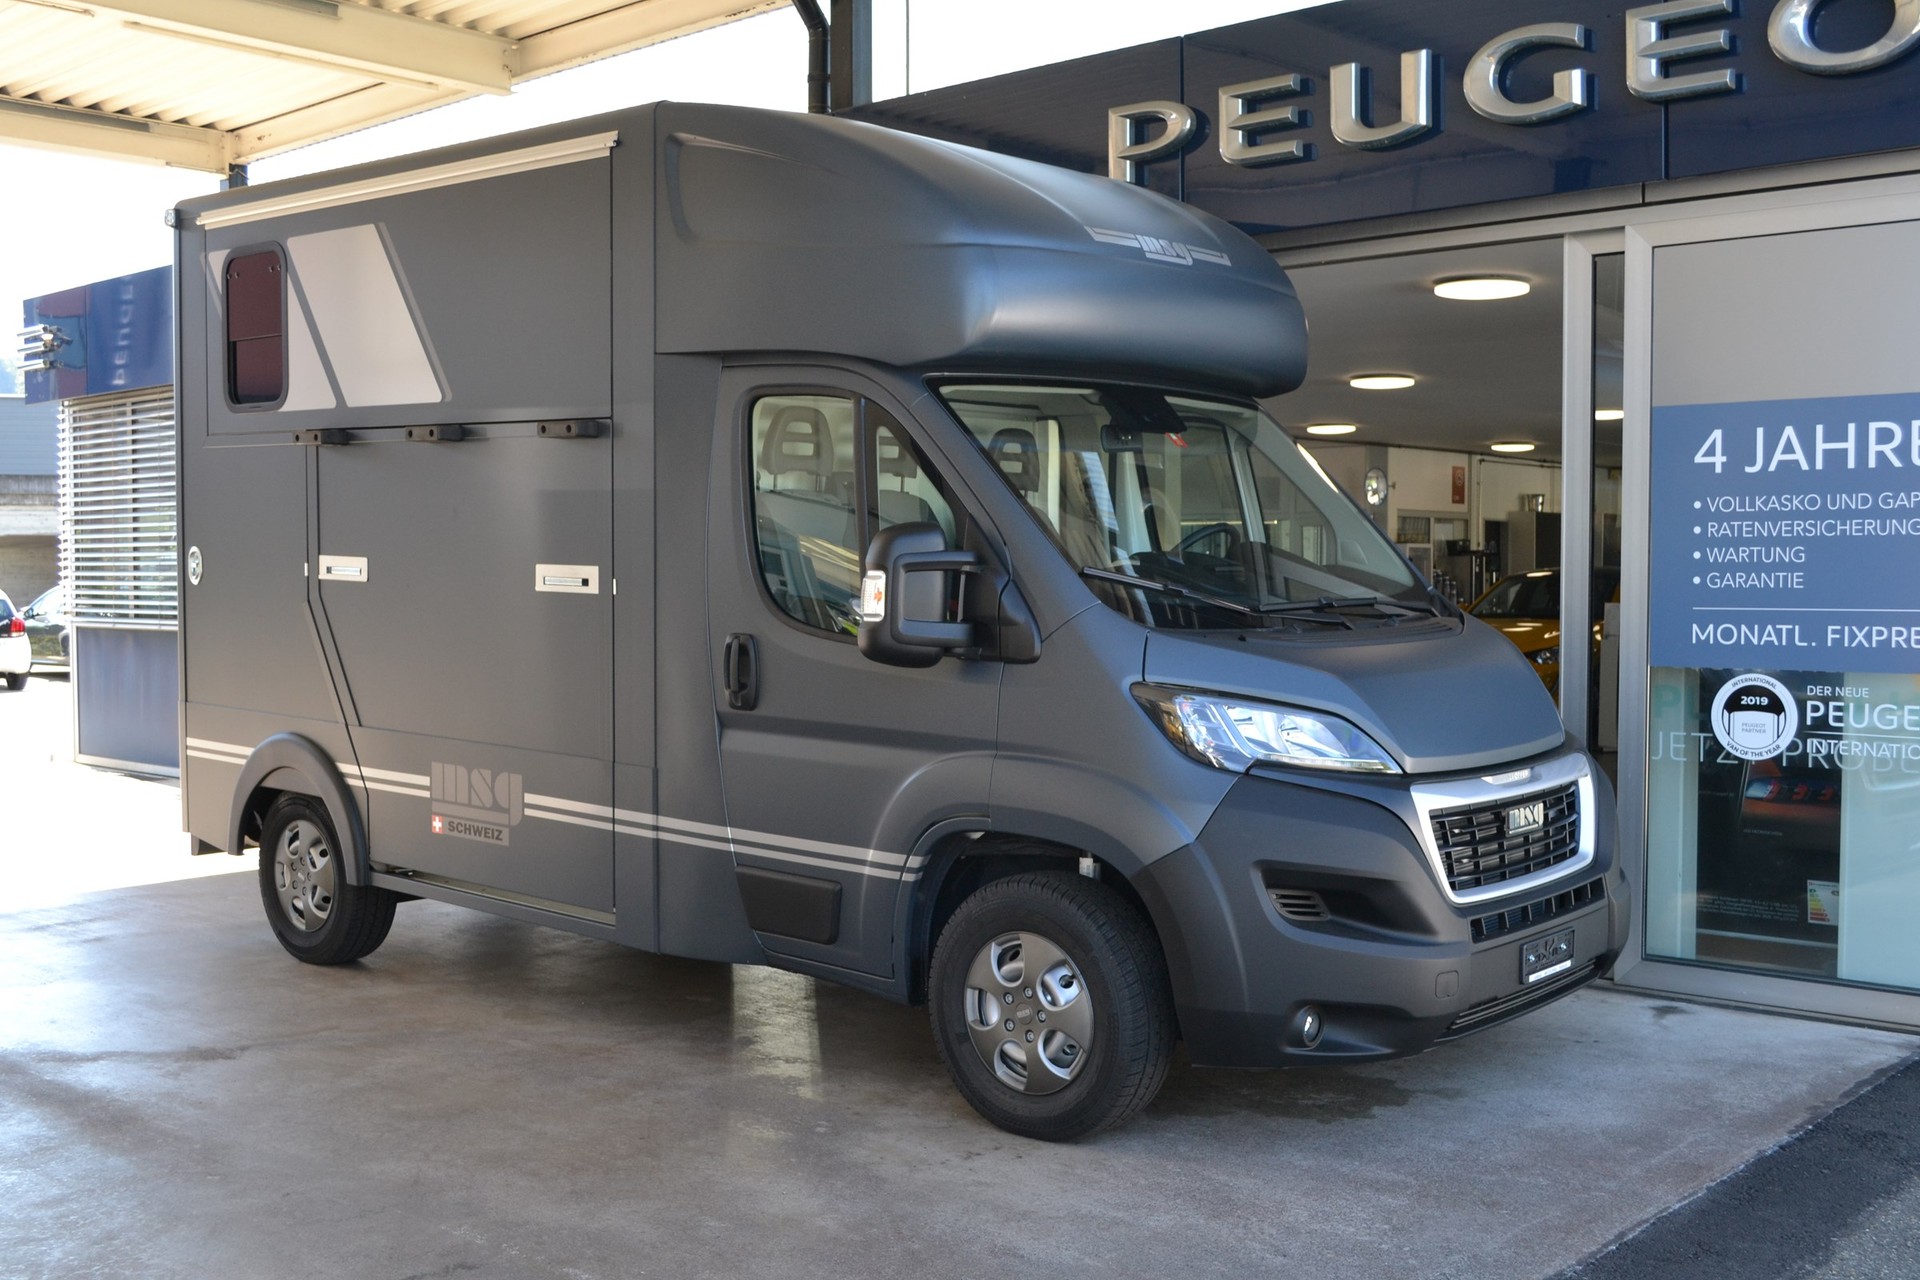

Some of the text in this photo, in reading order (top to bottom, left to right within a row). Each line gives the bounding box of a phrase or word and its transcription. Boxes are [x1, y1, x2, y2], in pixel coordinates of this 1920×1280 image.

[1694, 428, 1727, 474] 4
[1706, 493, 1821, 513] VOLLKASKO
[1827, 492, 1872, 510] UND
[1707, 518, 1920, 538] RATENVERSICHERUNG
[1706, 546, 1806, 563] WARTUNG
[1706, 572, 1805, 589] GARANTIE
[1692, 623, 1816, 647] MONATL.
[1731, 677, 1777, 690] INTERNATIONAL
[1807, 685, 1869, 698] DER NEUE
[1740, 695, 1769, 706] 2019
[1806, 700, 1920, 731] PEUGE
[1726, 741, 1782, 758] VAN OF THE YEAR
[447, 820, 504, 842] SCHWEIZ
